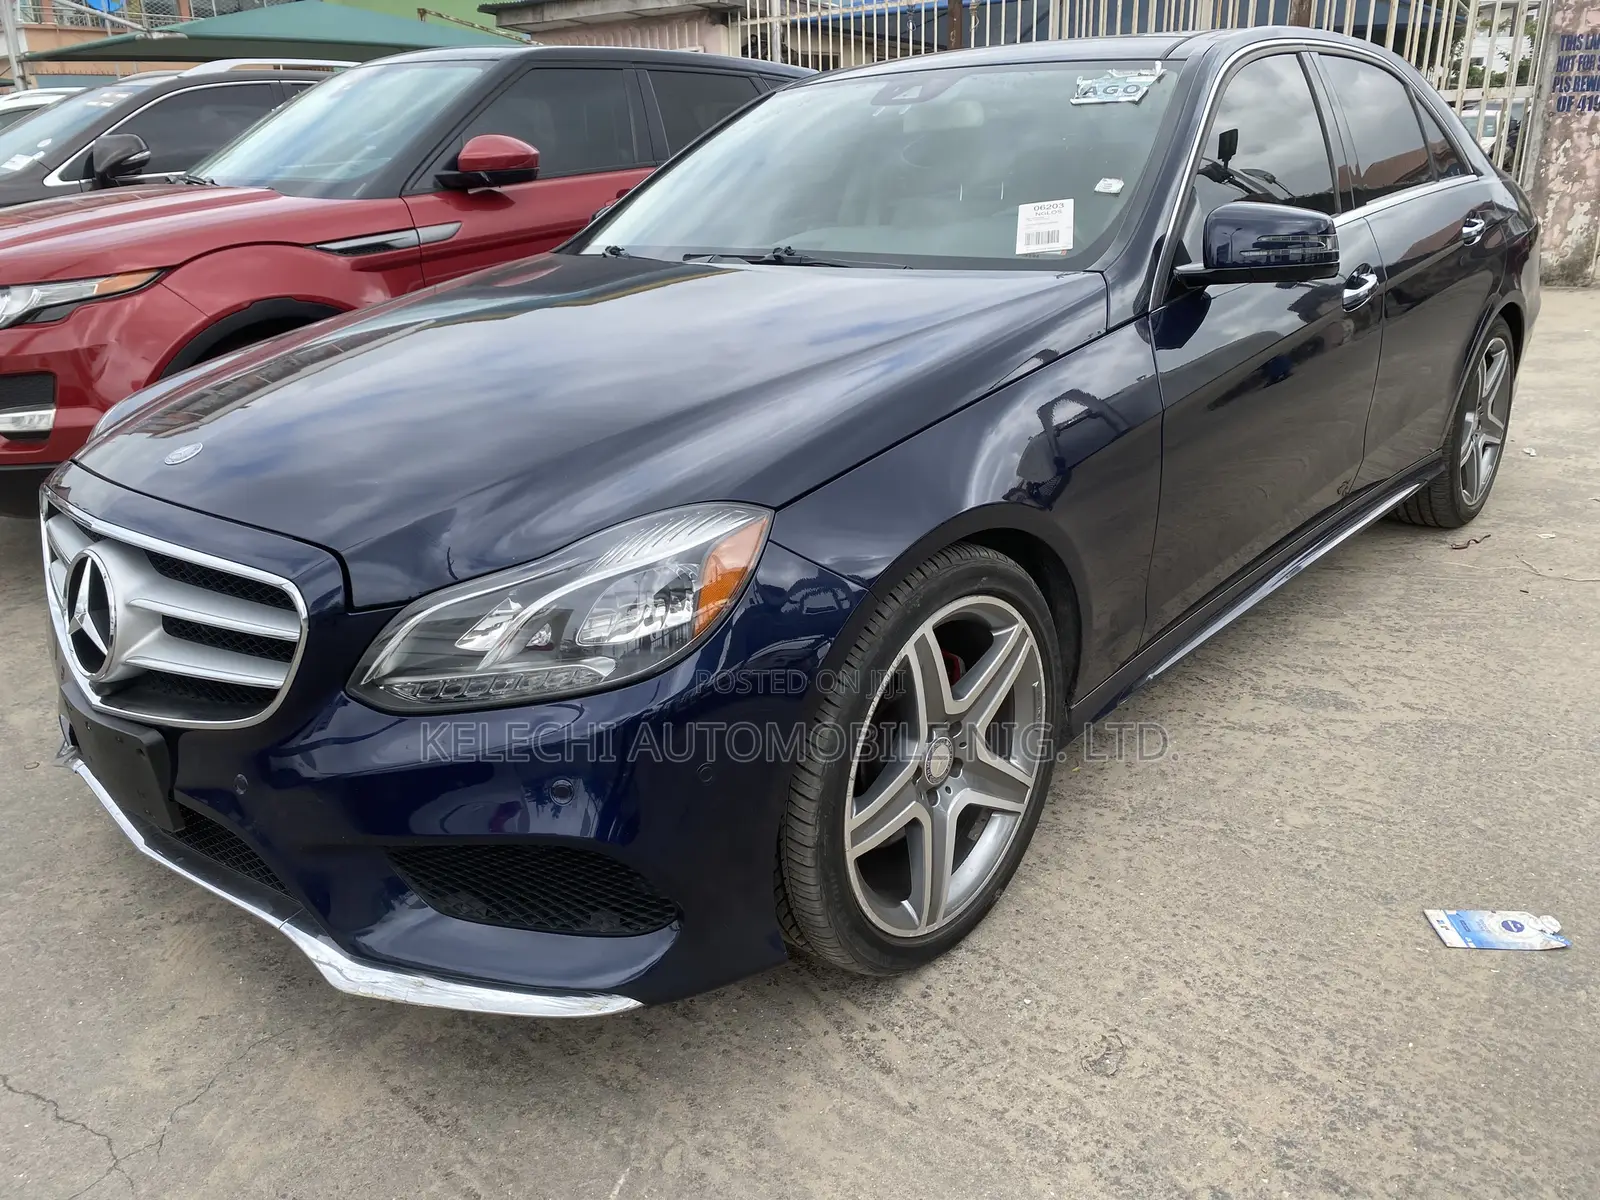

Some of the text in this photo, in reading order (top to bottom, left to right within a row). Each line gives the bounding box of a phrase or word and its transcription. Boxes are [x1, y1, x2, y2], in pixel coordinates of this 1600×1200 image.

[1560, 34, 1583, 51] THIS
[1556, 55, 1576, 72] NOT
[1577, 54, 1596, 72] FOR
[1552, 75, 1572, 93] PLS
[1557, 95, 1575, 112] OF
[1033, 202, 1065, 211] 06203
